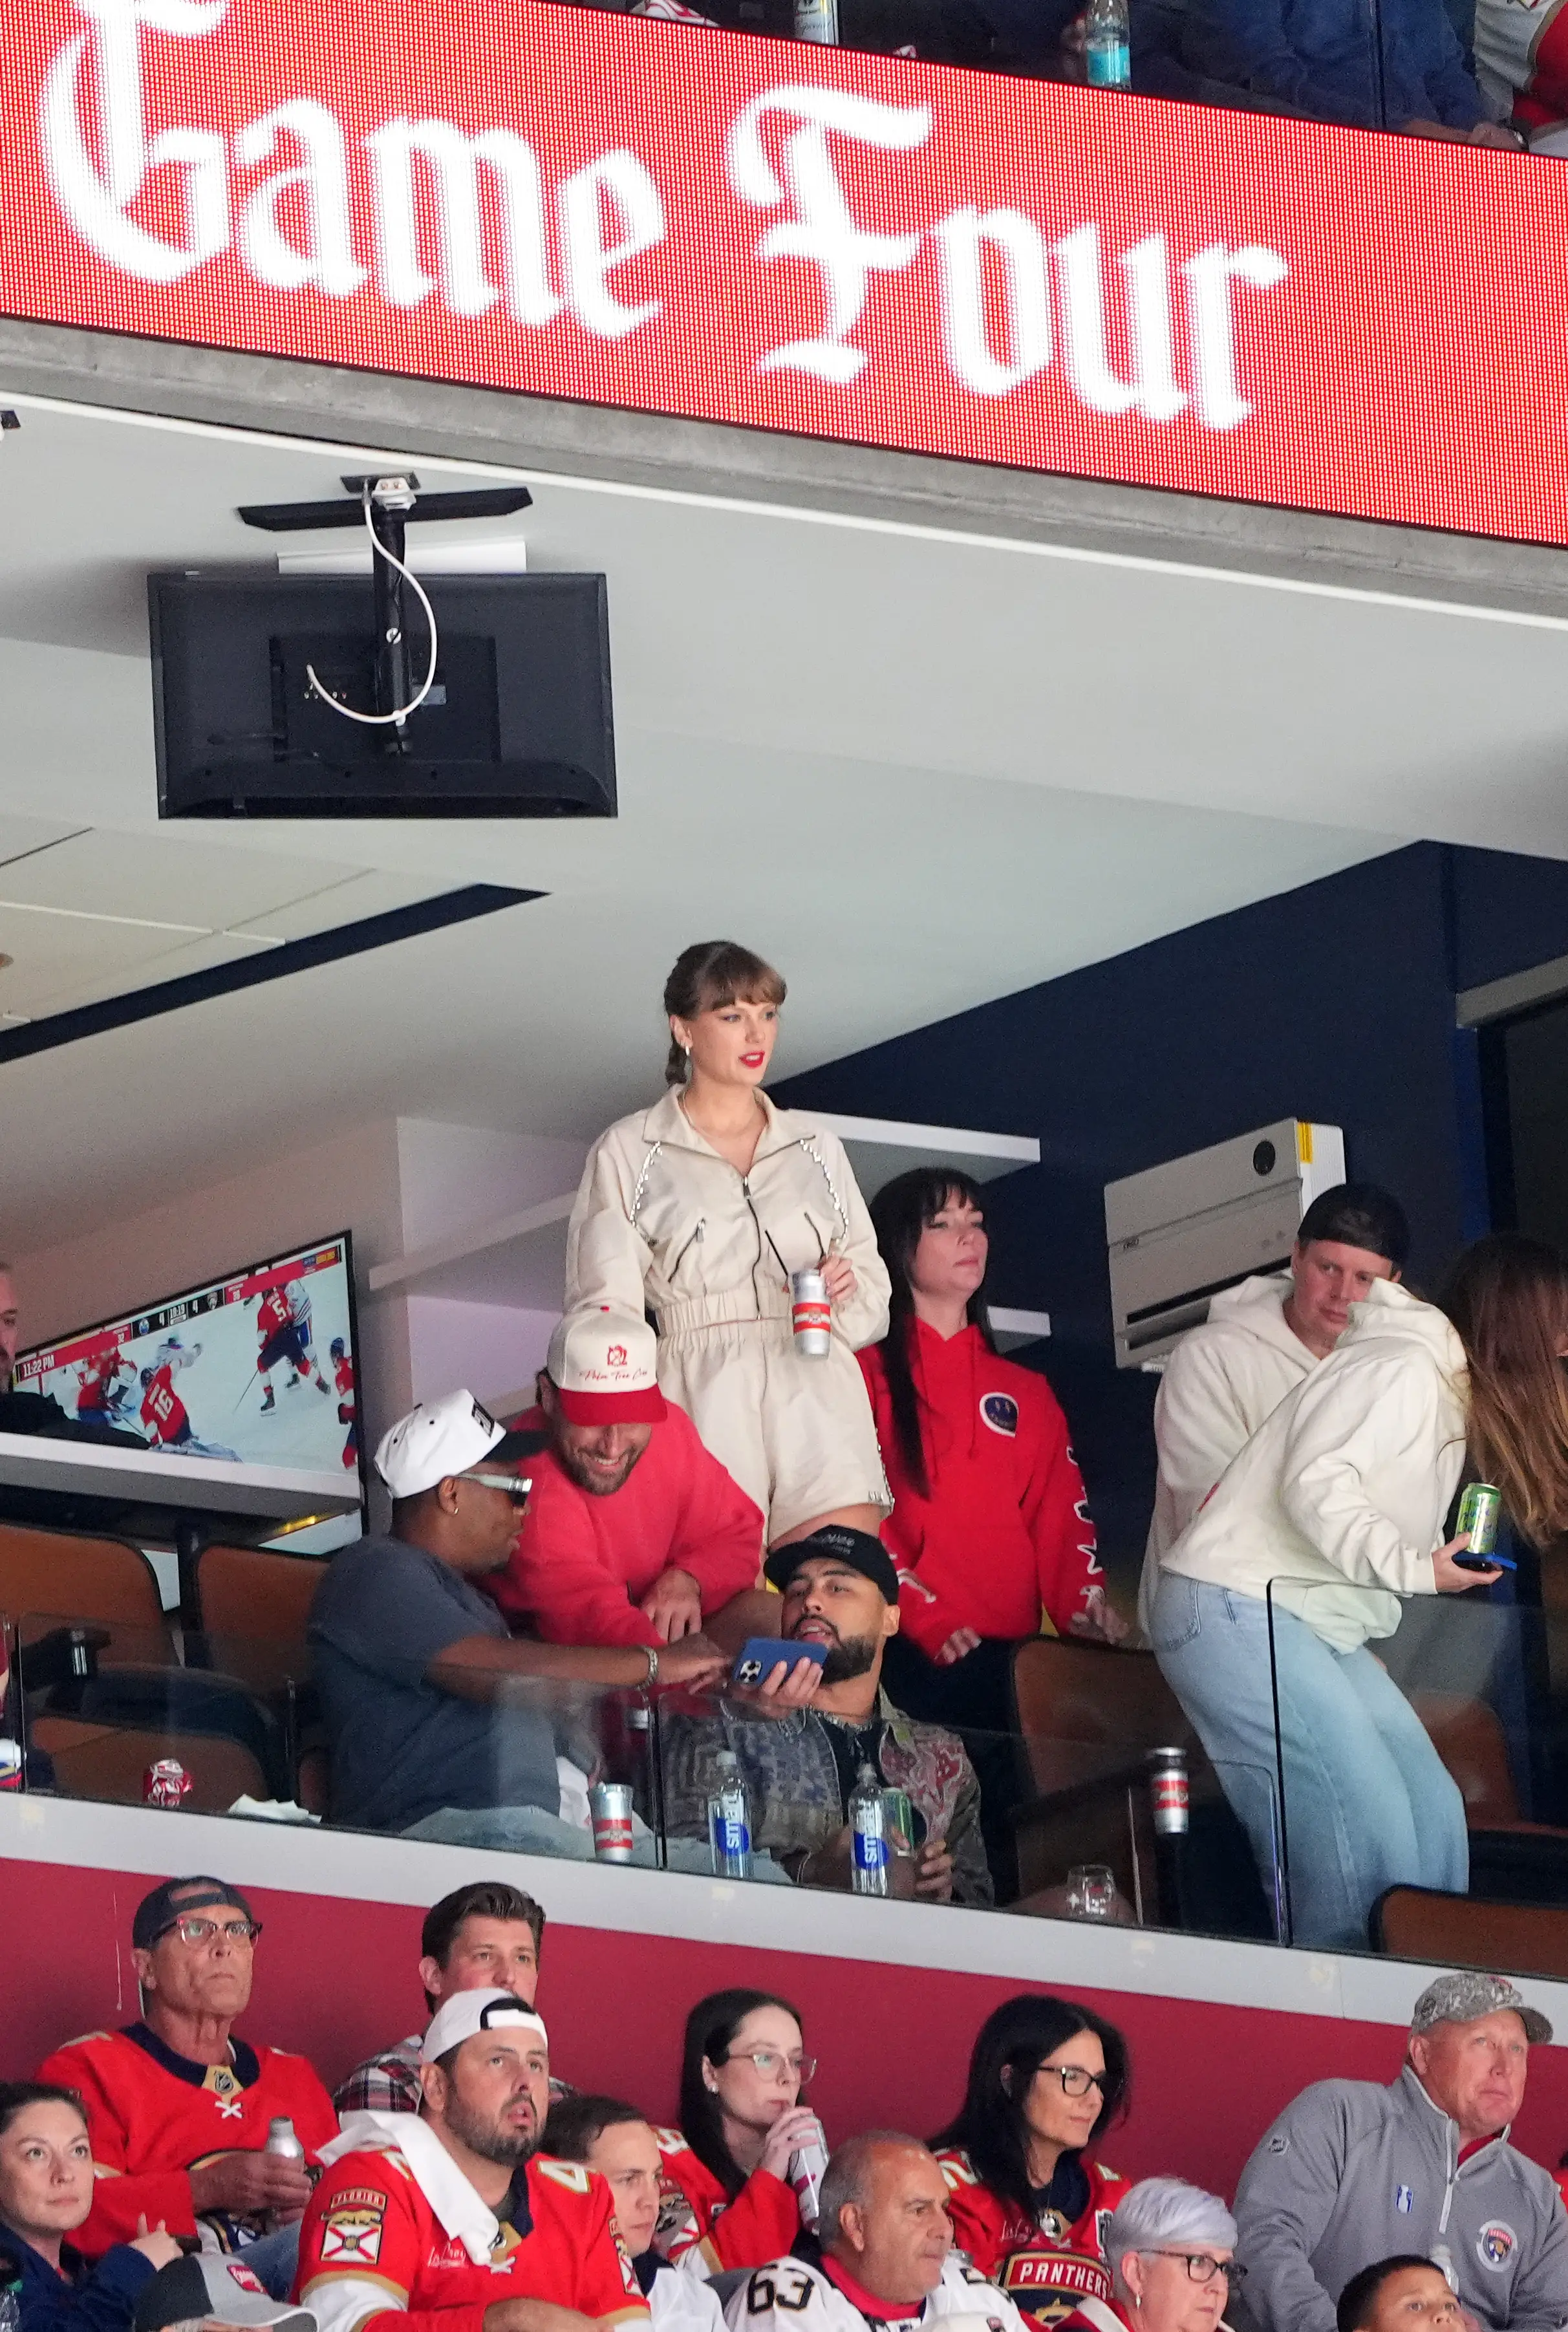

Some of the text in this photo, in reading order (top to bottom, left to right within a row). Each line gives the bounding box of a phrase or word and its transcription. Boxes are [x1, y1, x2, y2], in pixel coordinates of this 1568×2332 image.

[40, 0, 1289, 430] Game Four
[43, 1354, 56, 1371] PM
[153, 1388, 174, 1421] 16
[747, 2263, 815, 2315] 63
[1019, 2261, 1108, 2300] PANTHERS
